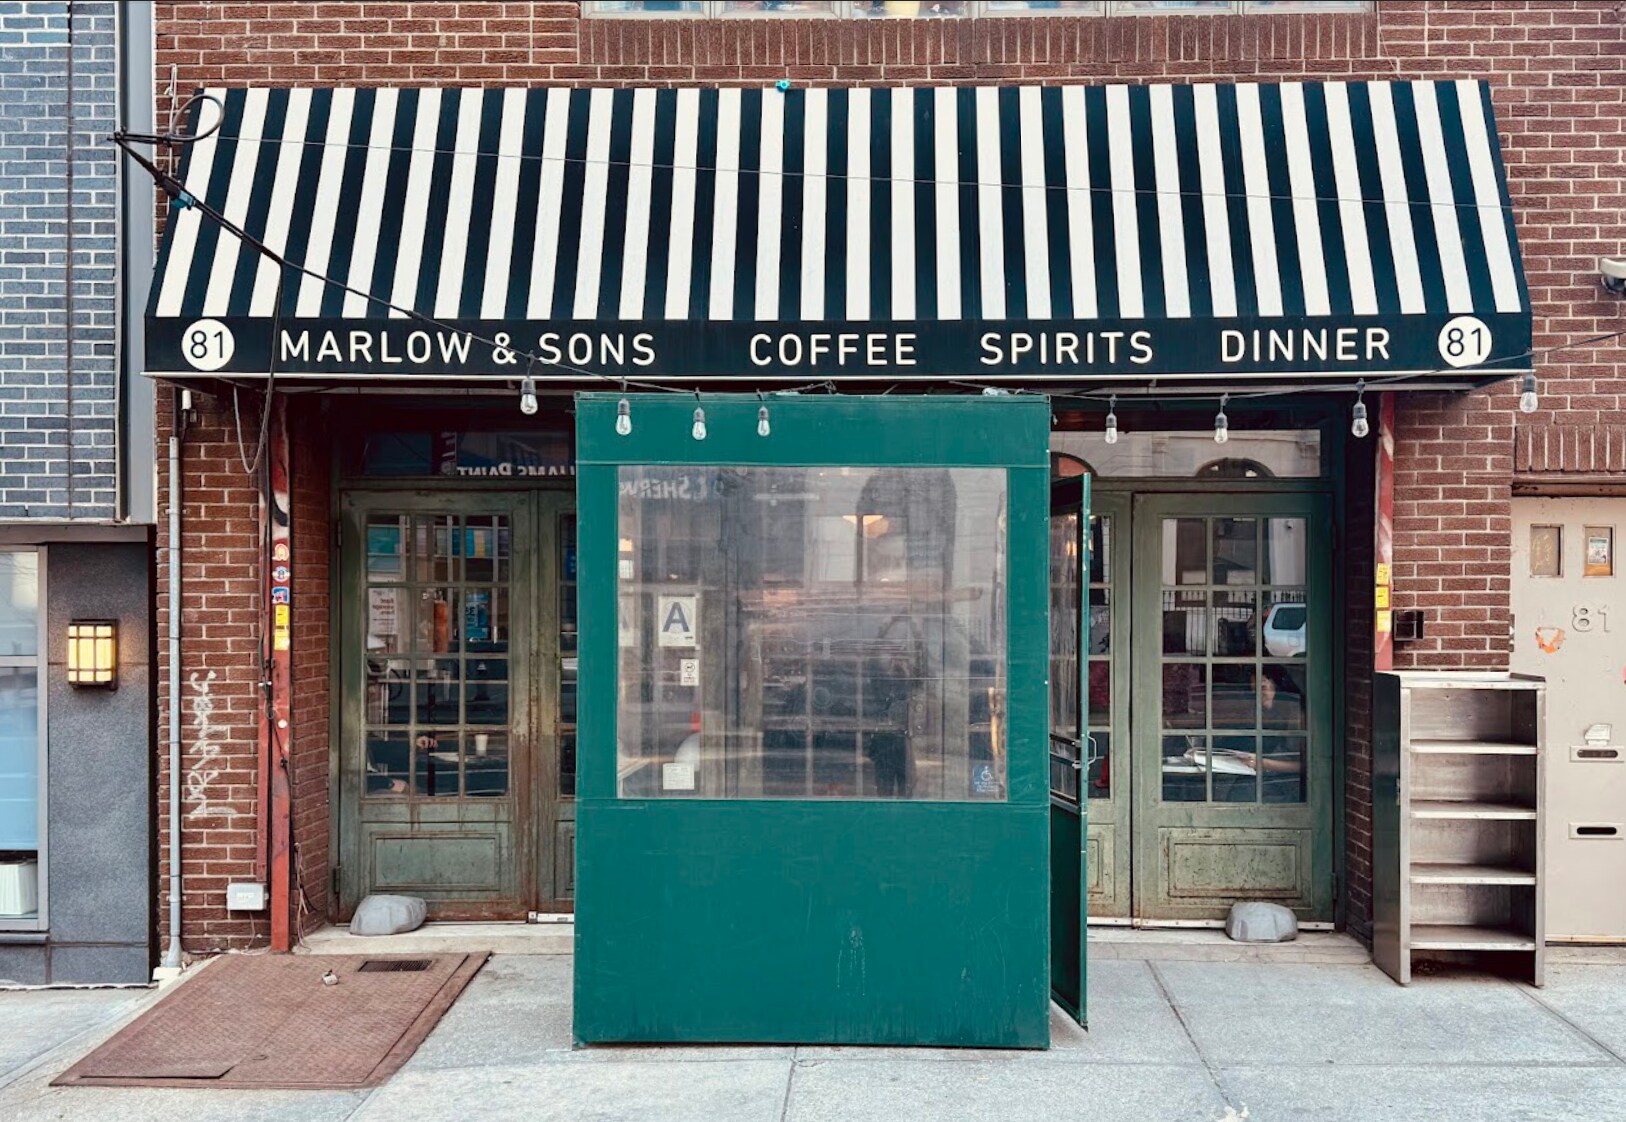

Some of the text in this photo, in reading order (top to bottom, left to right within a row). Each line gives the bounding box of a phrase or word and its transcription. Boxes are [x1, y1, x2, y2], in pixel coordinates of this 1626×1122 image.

[190, 330, 224, 359] 81
[280, 330, 656, 366] MARLOW & SONS
[749, 333, 918, 366] COFFEE
[979, 332, 1154, 366] SPIRITS
[1220, 327, 1391, 363] DINNER
[1446, 327, 1483, 357] 81
[662, 601, 690, 632] A
[1571, 603, 1612, 633] 81
